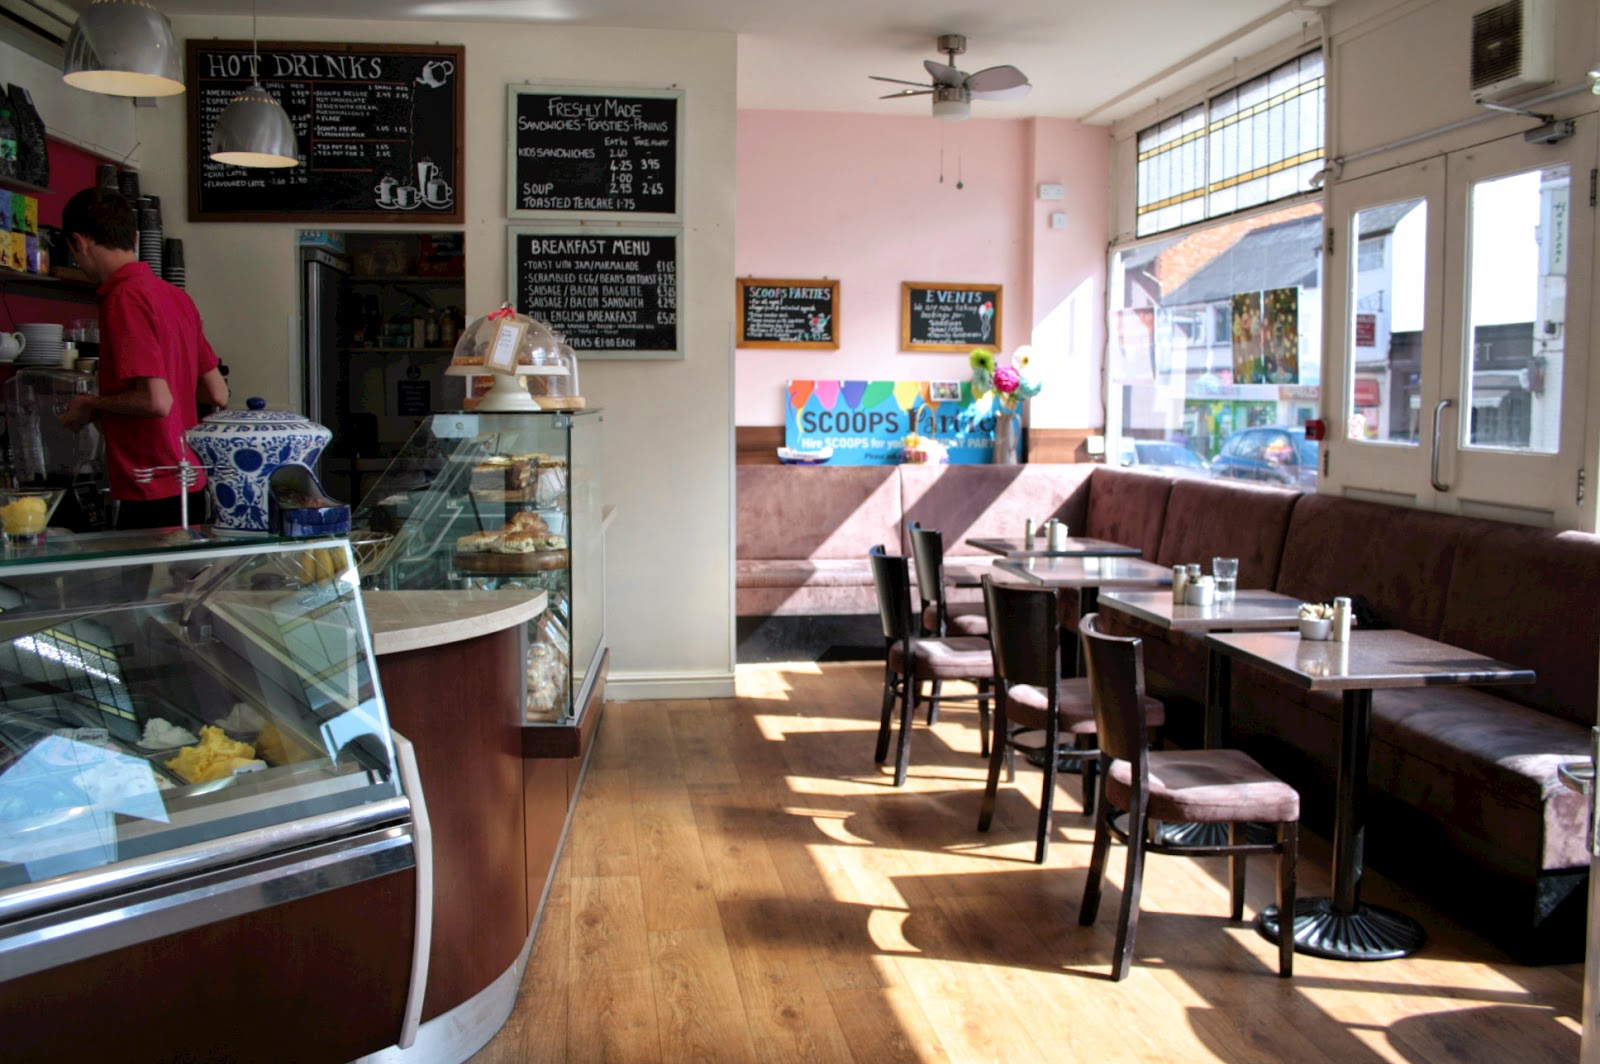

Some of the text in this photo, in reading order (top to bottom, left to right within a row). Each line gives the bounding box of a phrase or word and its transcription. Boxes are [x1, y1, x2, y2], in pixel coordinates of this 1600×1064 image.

[207, 53, 382, 79] HOT DRINKS
[548, 96, 643, 118] FRESHLY MADE
[518, 147, 536, 157] KIDS
[536, 148, 596, 158] SANDWICHES
[523, 182, 554, 195] SOUP
[523, 196, 571, 209] TOASTED
[573, 196, 614, 210] TEACAKE
[531, 239, 650, 256] BREAKFAST MENU
[527, 260, 552, 270] TOAST
[555, 260, 572, 269] WITH
[528, 273, 576, 284] SCRAMBLED
[528, 284, 562, 296] SAUSAGE
[570, 285, 599, 296] BACON
[602, 285, 642, 296] BAGUETTE
[749, 286, 831, 301] SCOOPS PARTIES
[528, 297, 562, 308] SAUSAGE
[570, 297, 599, 308] BACON
[602, 297, 644, 308] SANDWICH
[926, 290, 983, 304] EVENTS
[551, 310, 585, 322] ENGLISH
[586, 310, 637, 323] BREAKFAST
[616, 338, 636, 348] EACH
[803, 411, 899, 433] SCOOPS
[802, 437, 822, 448] Hire
[825, 437, 868, 449] SCOOPS
[871, 437, 884, 448] for
